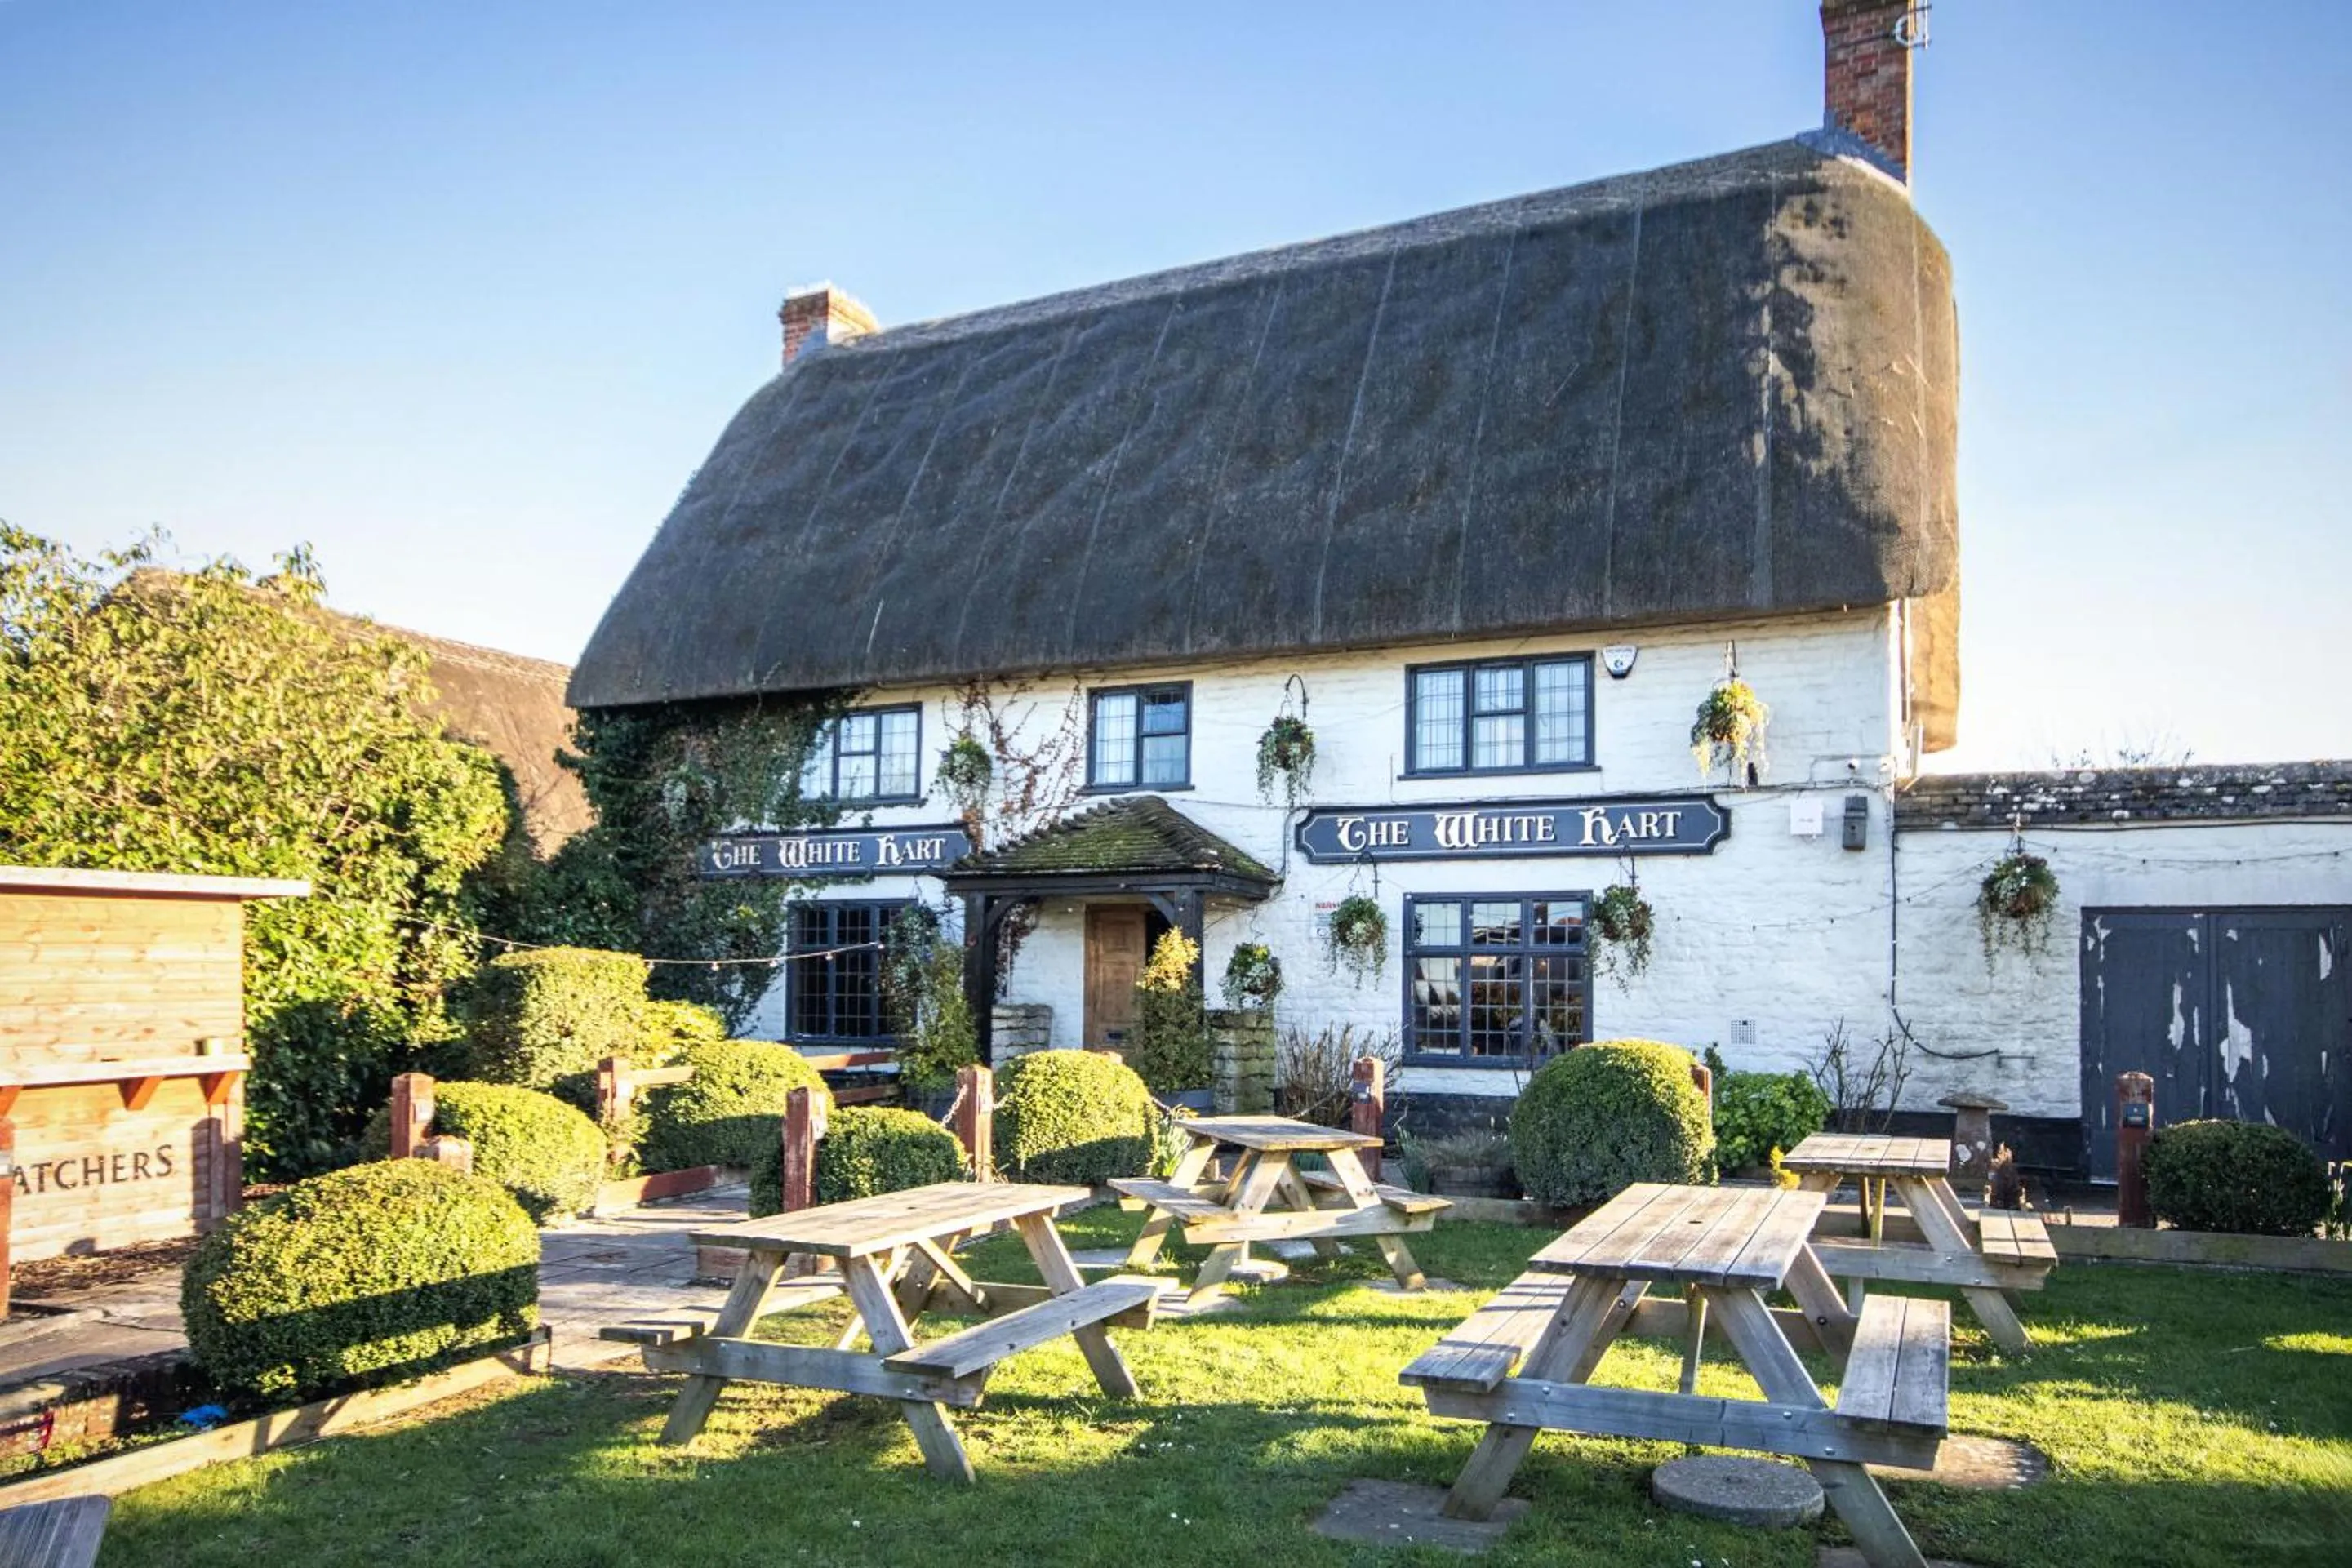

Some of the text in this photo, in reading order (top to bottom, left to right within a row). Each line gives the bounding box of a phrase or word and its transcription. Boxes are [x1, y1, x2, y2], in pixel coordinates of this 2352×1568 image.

[1336, 806, 1682, 851] THE WHITE HART
[711, 833, 946, 870] THE WHITE HART
